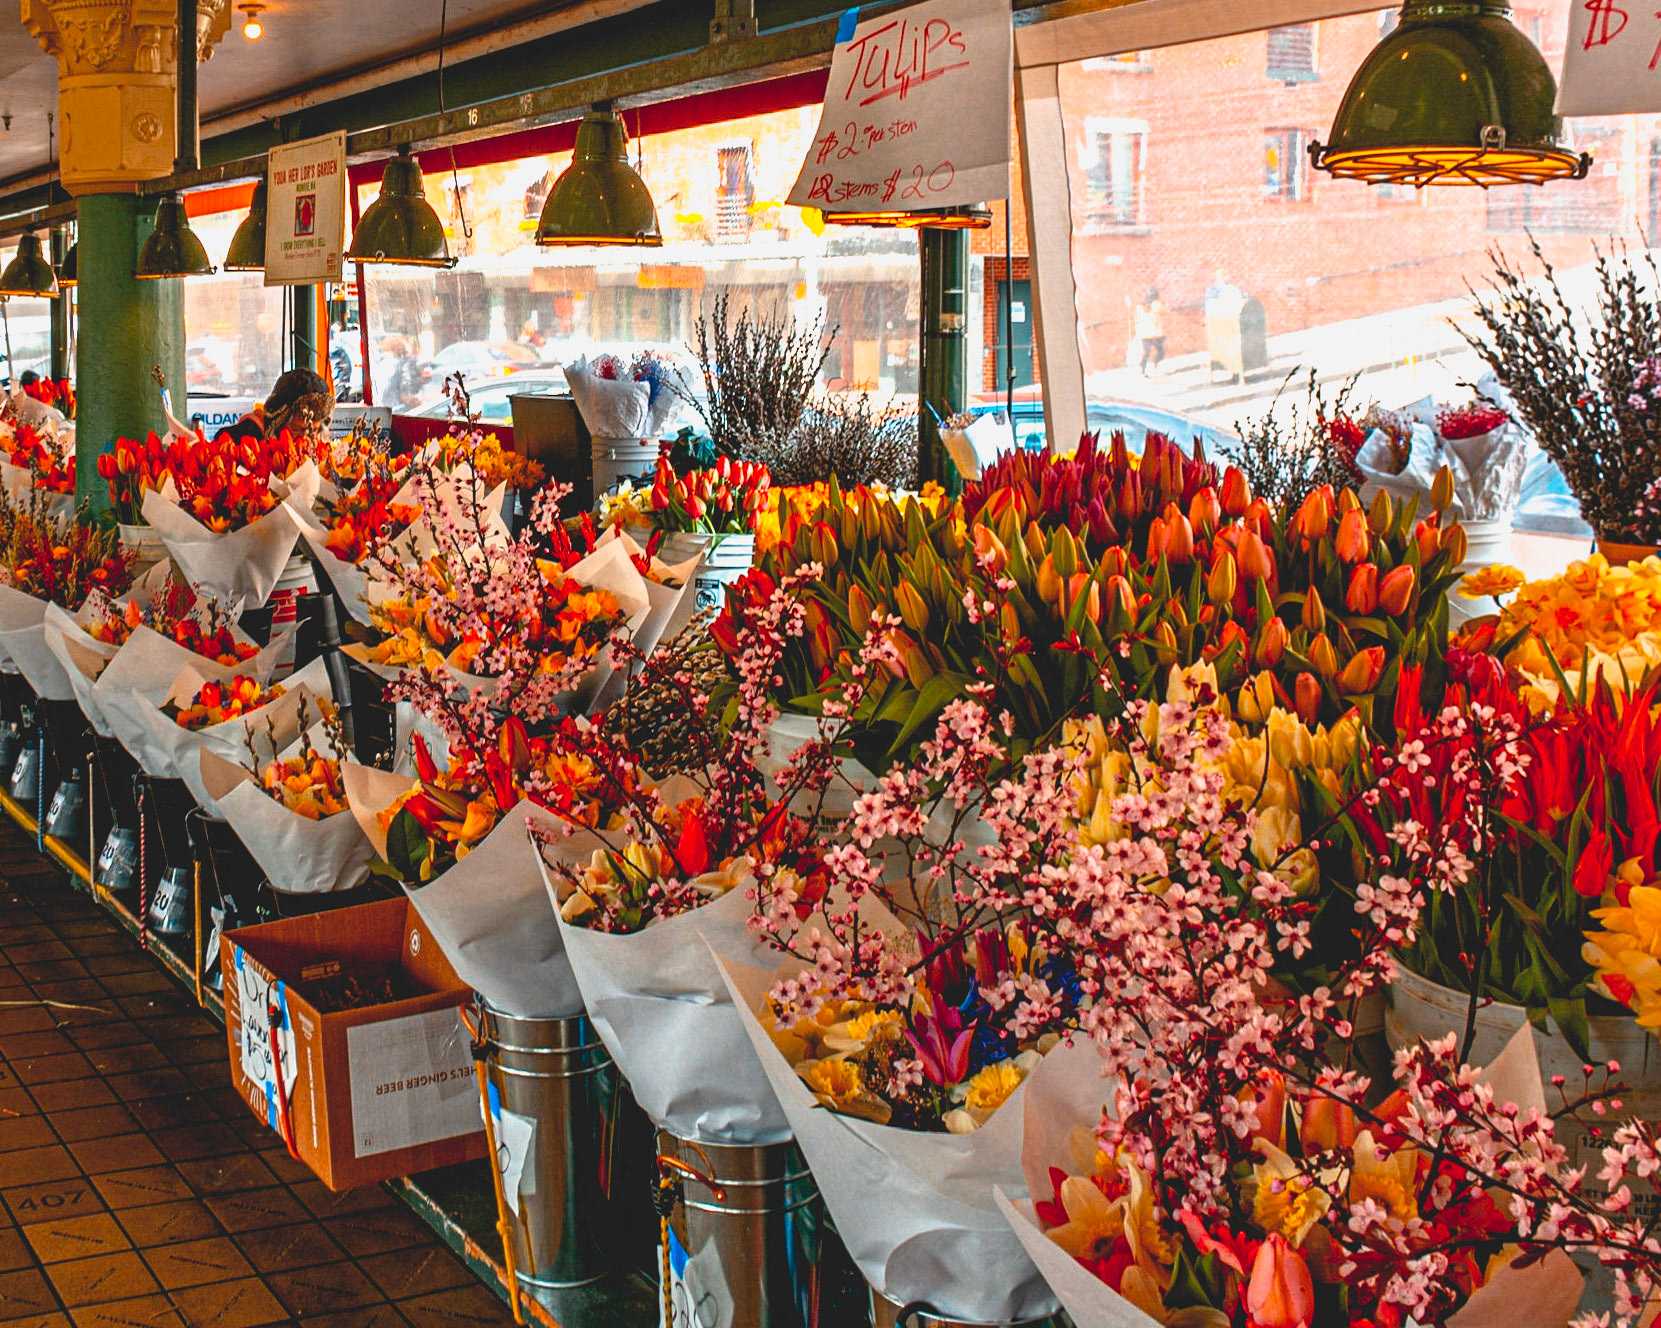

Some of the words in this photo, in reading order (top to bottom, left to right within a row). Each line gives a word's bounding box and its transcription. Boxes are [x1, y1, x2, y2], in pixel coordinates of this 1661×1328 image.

[467, 108, 478, 126] 16
[887, 119, 918, 141] stem
[288, 167, 299, 183] HER
[317, 160, 338, 178] GARDEN
[834, 179, 880, 201] stems
[102, 844, 114, 860] 20
[154, 891, 169, 912] 20
[375, 1080, 404, 1096] BEER
[405, 1071, 448, 1090] GINGER
[17, 1188, 88, 1212] 407
